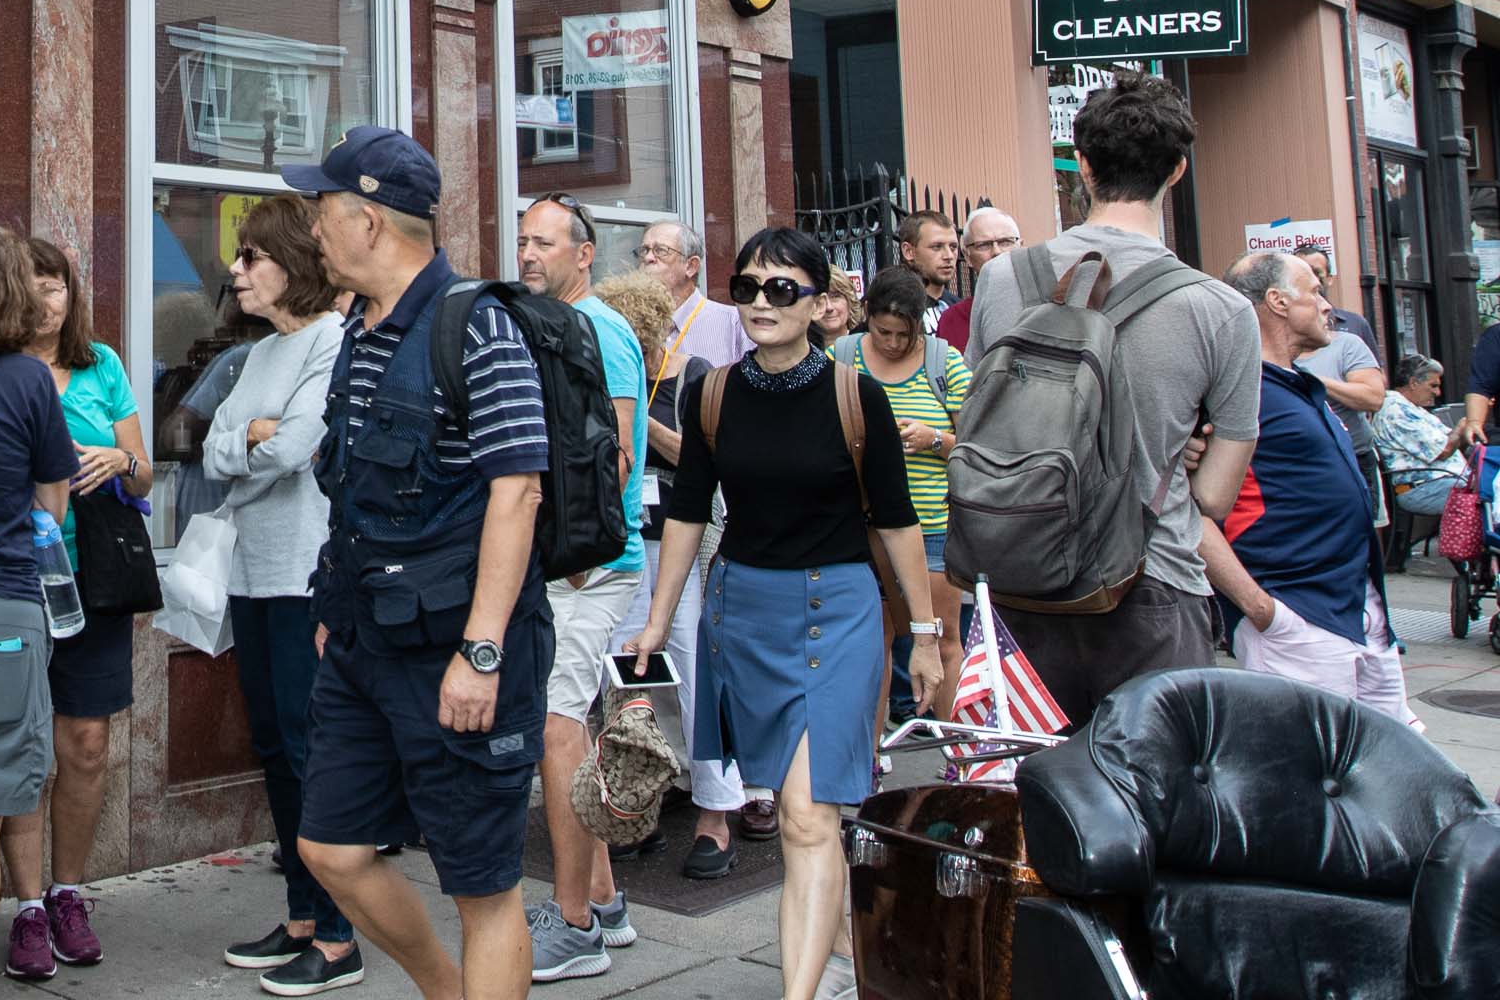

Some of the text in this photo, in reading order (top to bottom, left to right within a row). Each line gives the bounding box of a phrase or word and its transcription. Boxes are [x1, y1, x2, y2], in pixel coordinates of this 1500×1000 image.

[1052, 10, 1223, 41] CLEANERS
[1248, 234, 1331, 250] Charlie Baker
